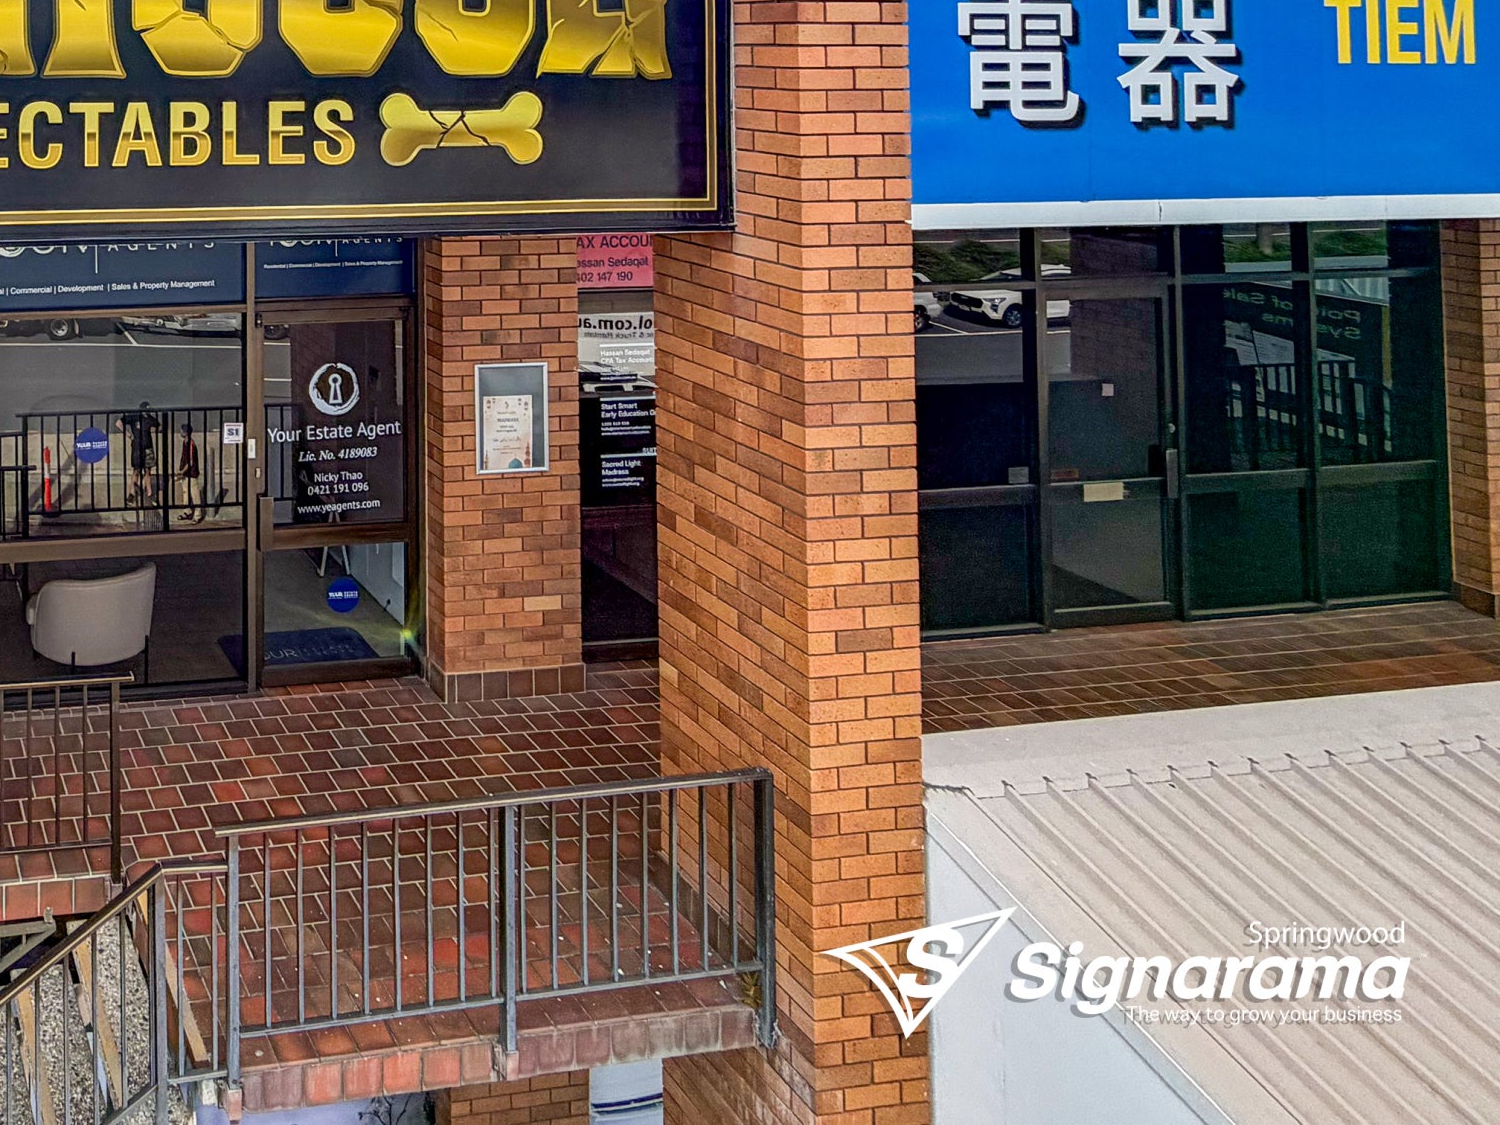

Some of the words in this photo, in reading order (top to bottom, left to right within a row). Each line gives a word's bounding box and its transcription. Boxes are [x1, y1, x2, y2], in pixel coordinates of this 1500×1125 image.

[10, 285, 53, 295] Commercial
[57, 283, 104, 294] Development
[111, 282, 131, 291] Sales
[132, 282, 139, 290] &
[139, 281, 169, 291] Property
[170, 279, 215, 289] Management
[601, 411, 617, 419] Early
[267, 427, 302, 443] Your
[306, 425, 353, 440] Estate
[357, 420, 402, 440] Agent
[298, 450, 317, 462] Lic.
[319, 449, 336, 461] No.
[338, 446, 378, 460] 4189083
[625, 460, 641, 468] Light
[313, 472, 339, 484] Nicky
[340, 471, 363, 481] Thao
[307, 484, 331, 496] 0421
[333, 483, 349, 493] 191
[351, 481, 370, 492] 096
[297, 499, 381, 515] www.yeagents.com
